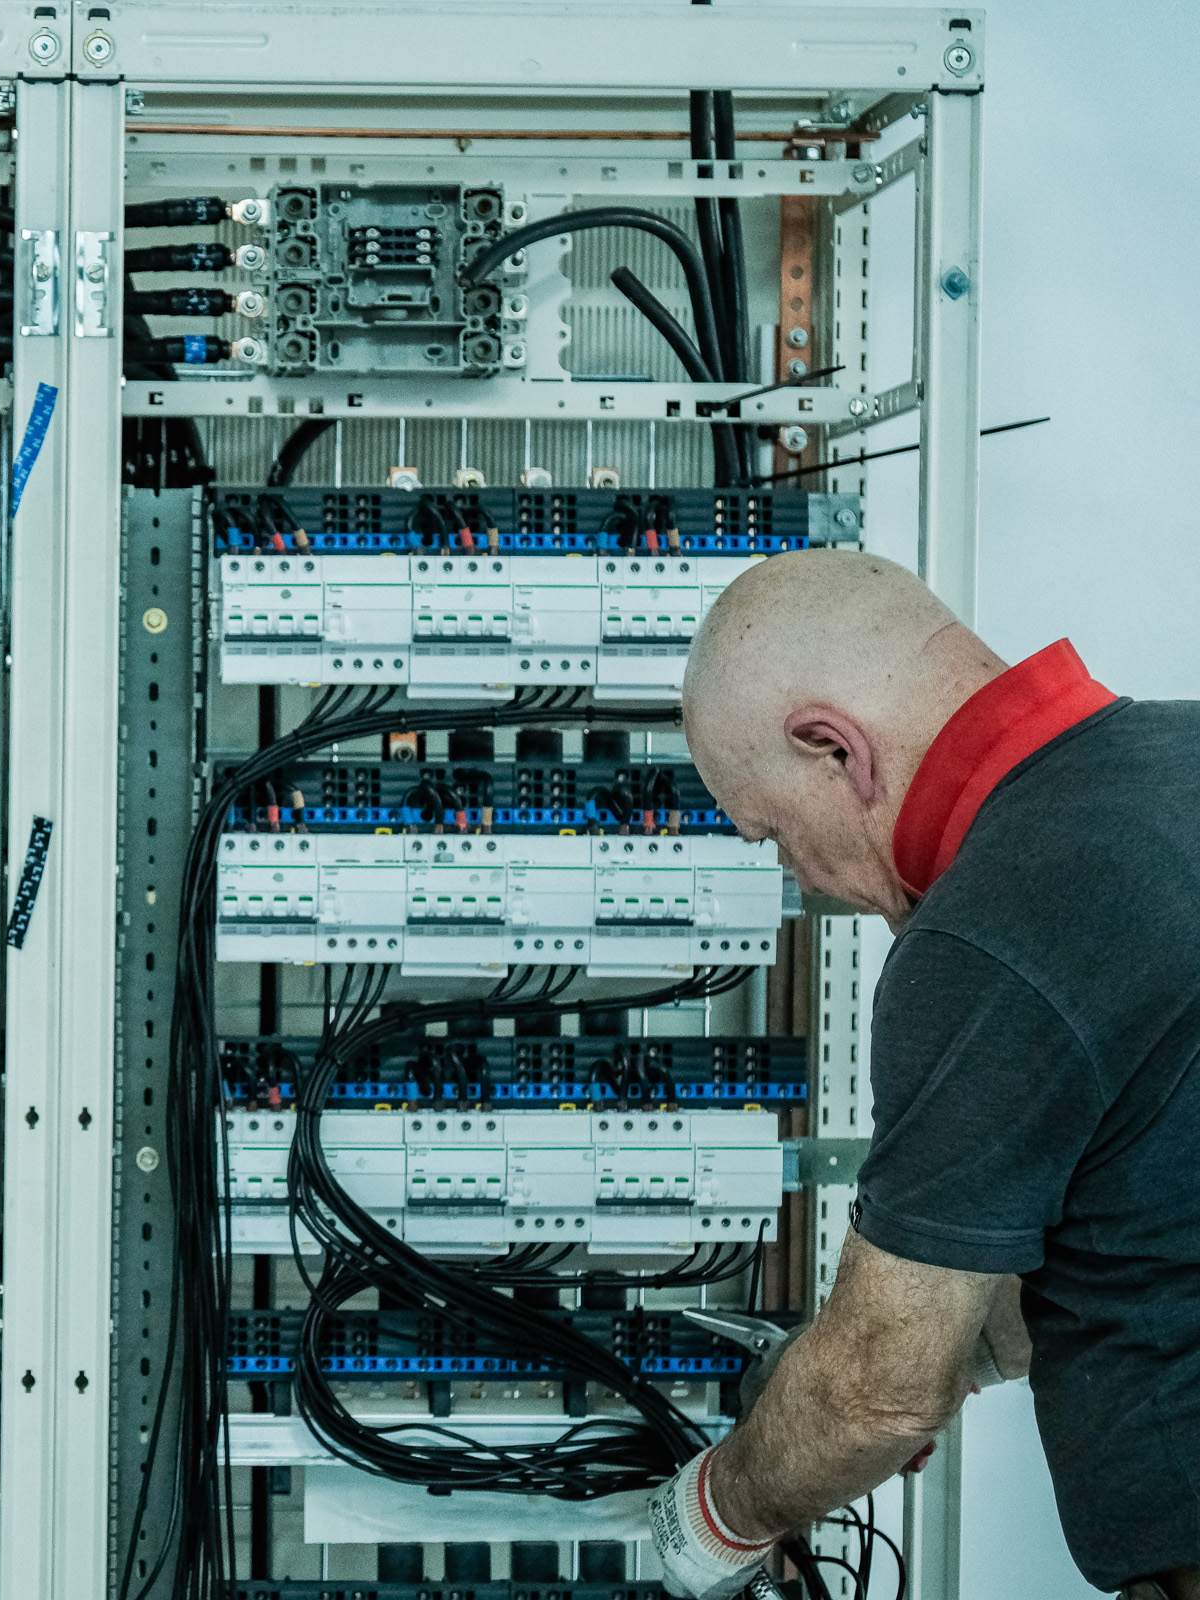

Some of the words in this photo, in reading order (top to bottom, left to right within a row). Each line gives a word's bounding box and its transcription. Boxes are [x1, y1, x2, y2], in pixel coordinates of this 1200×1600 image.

[44, 405, 52, 415] N
[34, 416, 43, 425] N
[32, 438, 42, 448] N
[23, 447, 32, 456] N
[35, 832, 45, 848] L1
[31, 866, 42, 881] L1
[21, 881, 32, 896] L1
[16, 914, 27, 930] L1
[8, 929, 18, 945] L1
